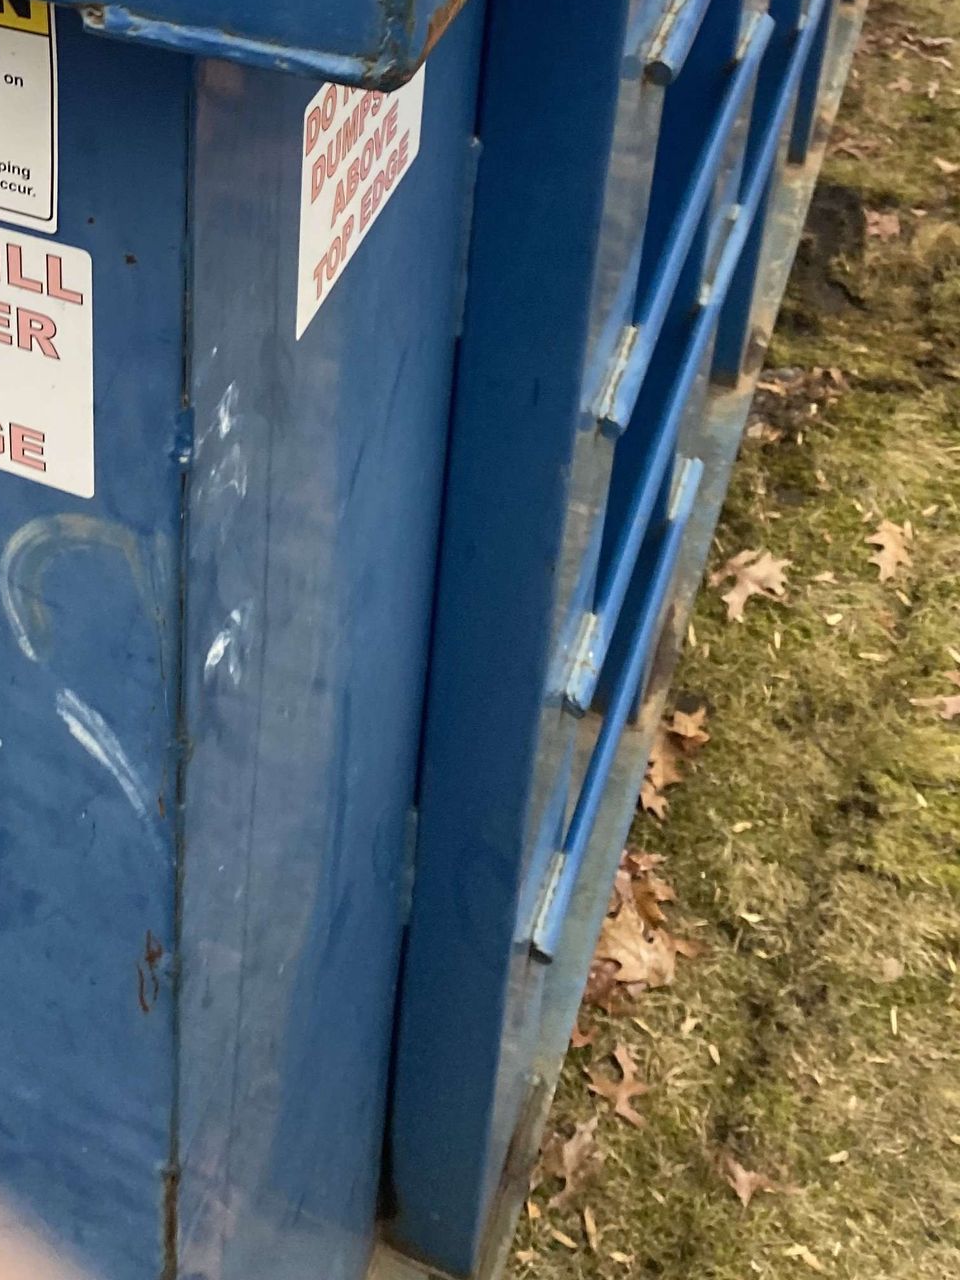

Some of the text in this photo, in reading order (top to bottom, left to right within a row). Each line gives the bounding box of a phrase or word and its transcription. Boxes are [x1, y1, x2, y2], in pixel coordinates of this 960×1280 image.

[4, 73, 24, 88] on
[305, 83, 337, 158] DO
[311, 89, 389, 205] DUMPS
[331, 97, 400, 229] ABOVE
[313, 128, 411, 301] TOP EDGE
